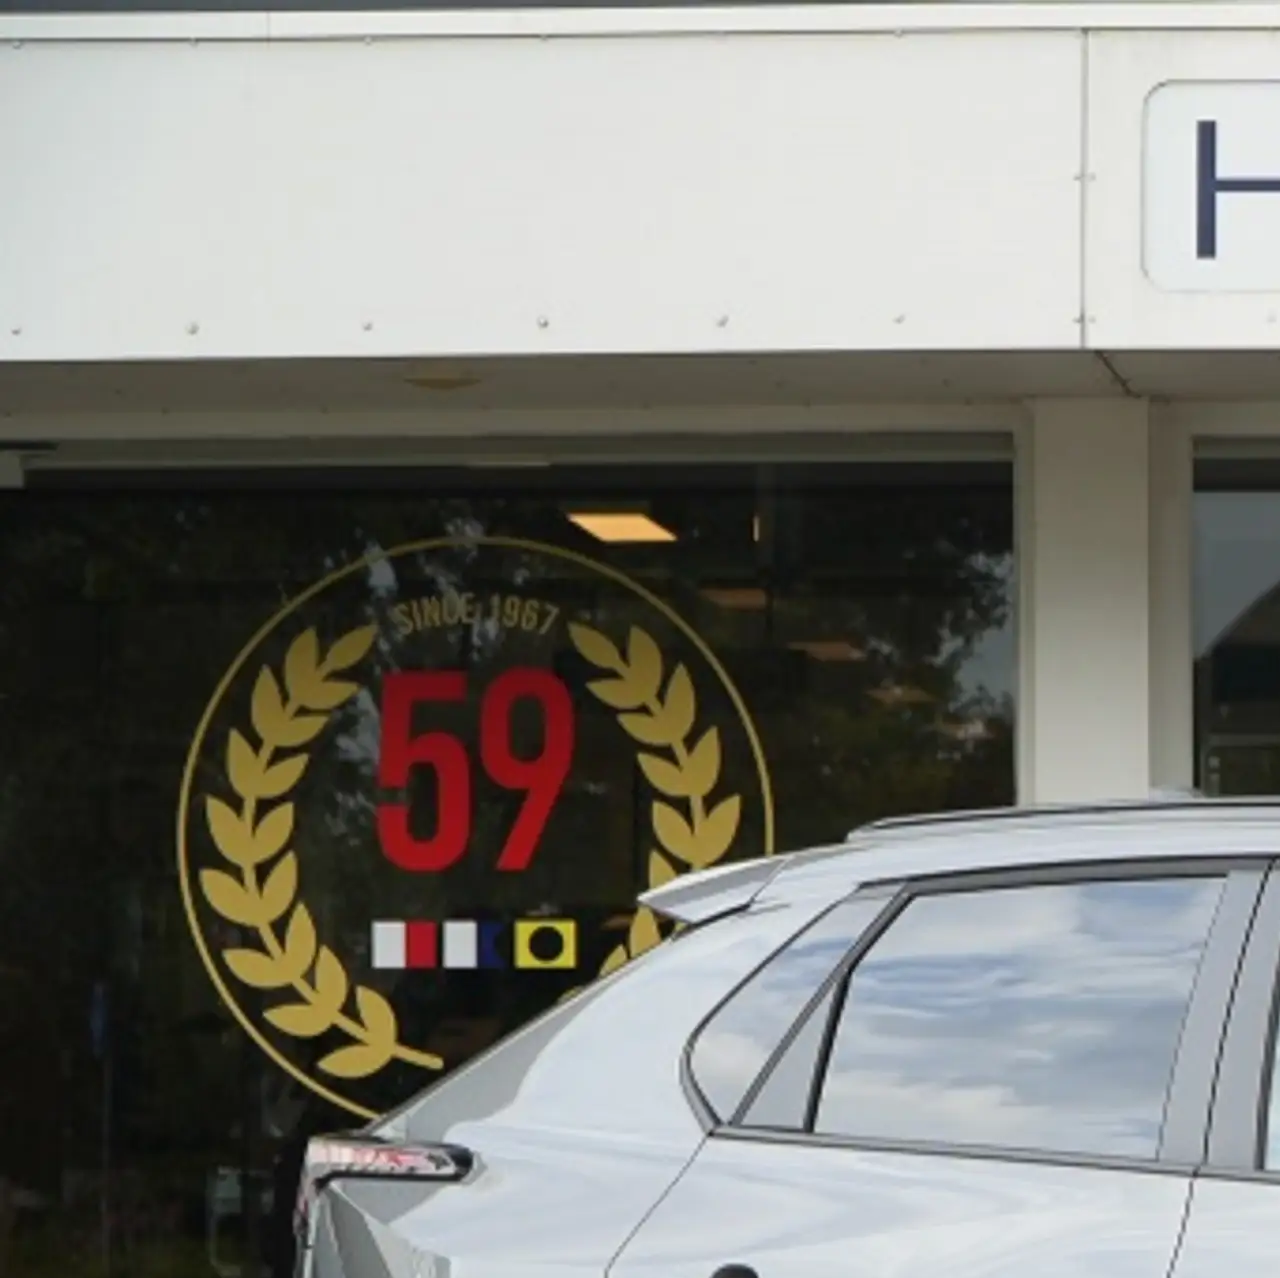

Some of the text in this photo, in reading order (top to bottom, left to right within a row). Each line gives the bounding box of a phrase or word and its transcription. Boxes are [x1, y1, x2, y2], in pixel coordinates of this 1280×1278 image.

[389, 590, 561, 636] SINCE 1967
[375, 667, 577, 874] 59
